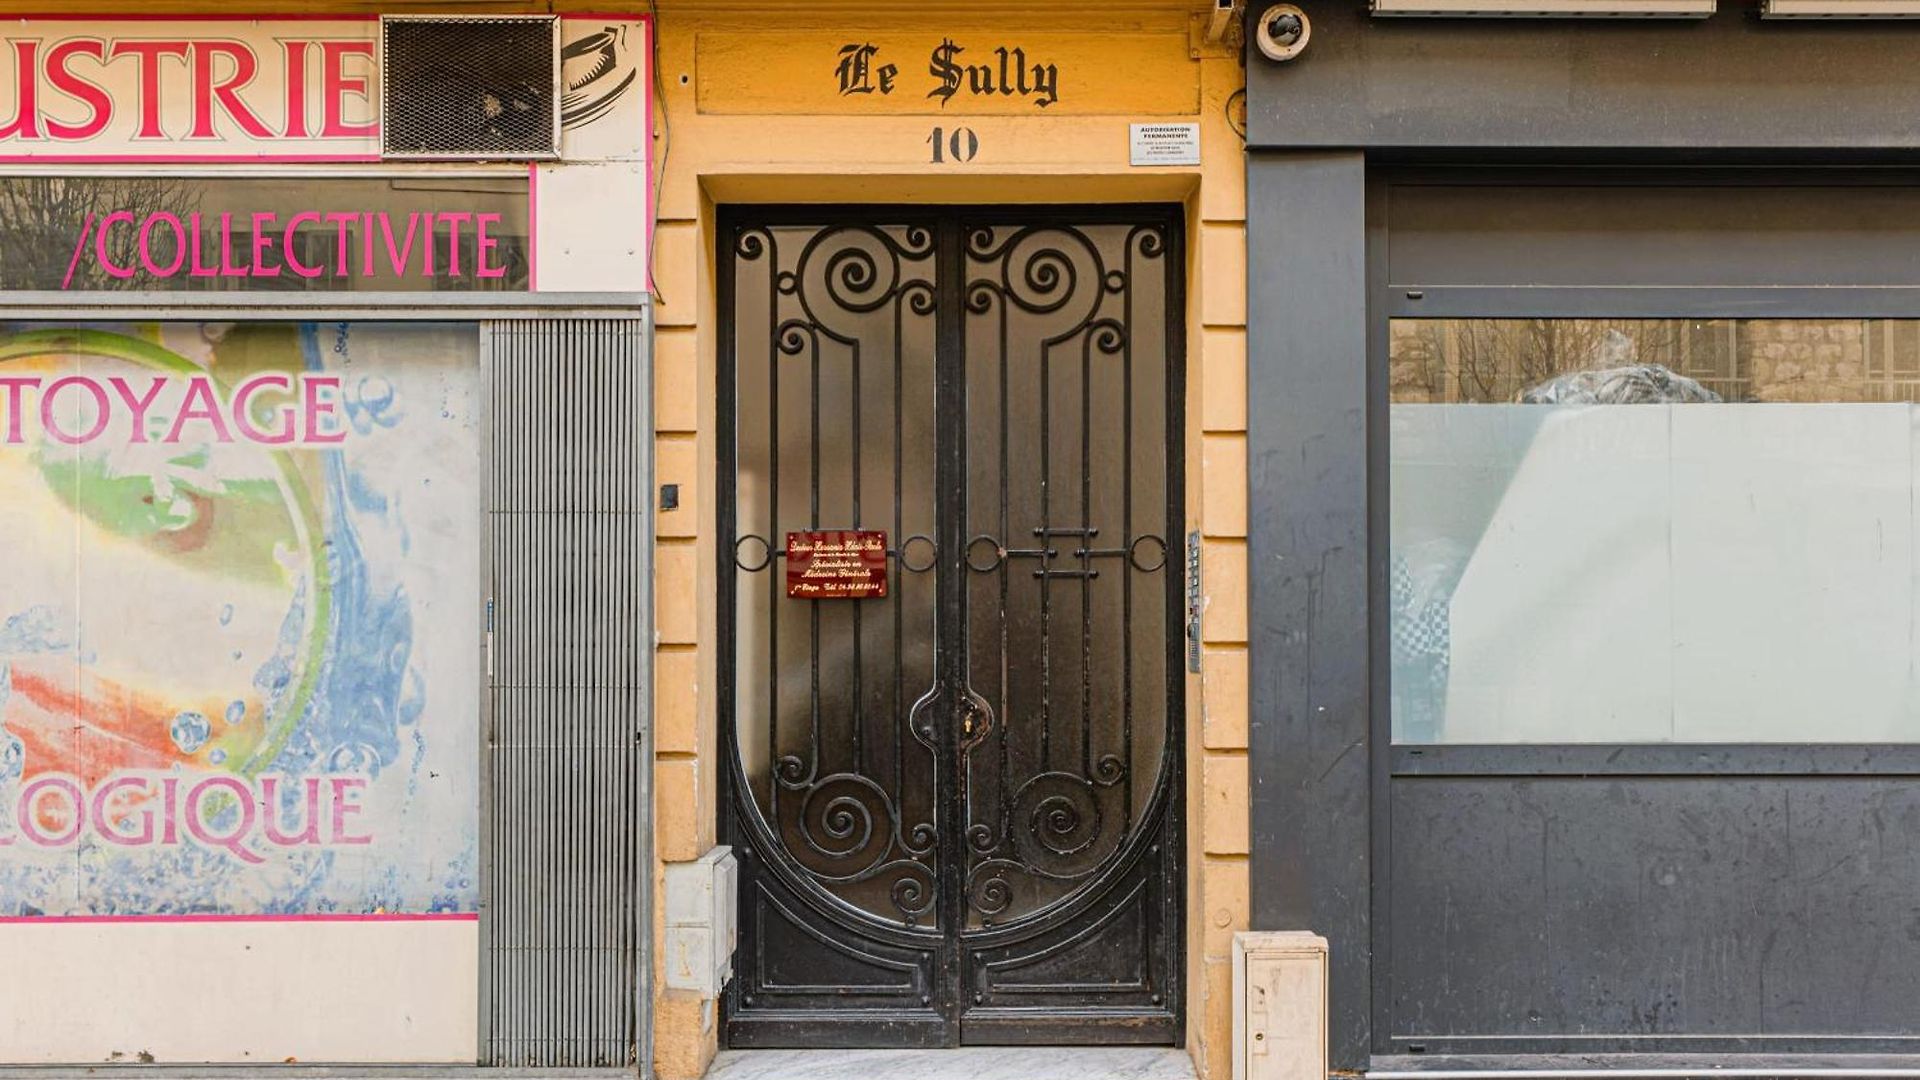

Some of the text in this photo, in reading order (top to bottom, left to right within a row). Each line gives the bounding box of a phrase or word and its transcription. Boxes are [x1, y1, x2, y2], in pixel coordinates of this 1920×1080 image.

[835, 42, 899, 97] Le
[926, 127, 979, 164] 10
[0, 376, 347, 445] TOYAGE
[0, 777, 373, 865] OGIQUE
